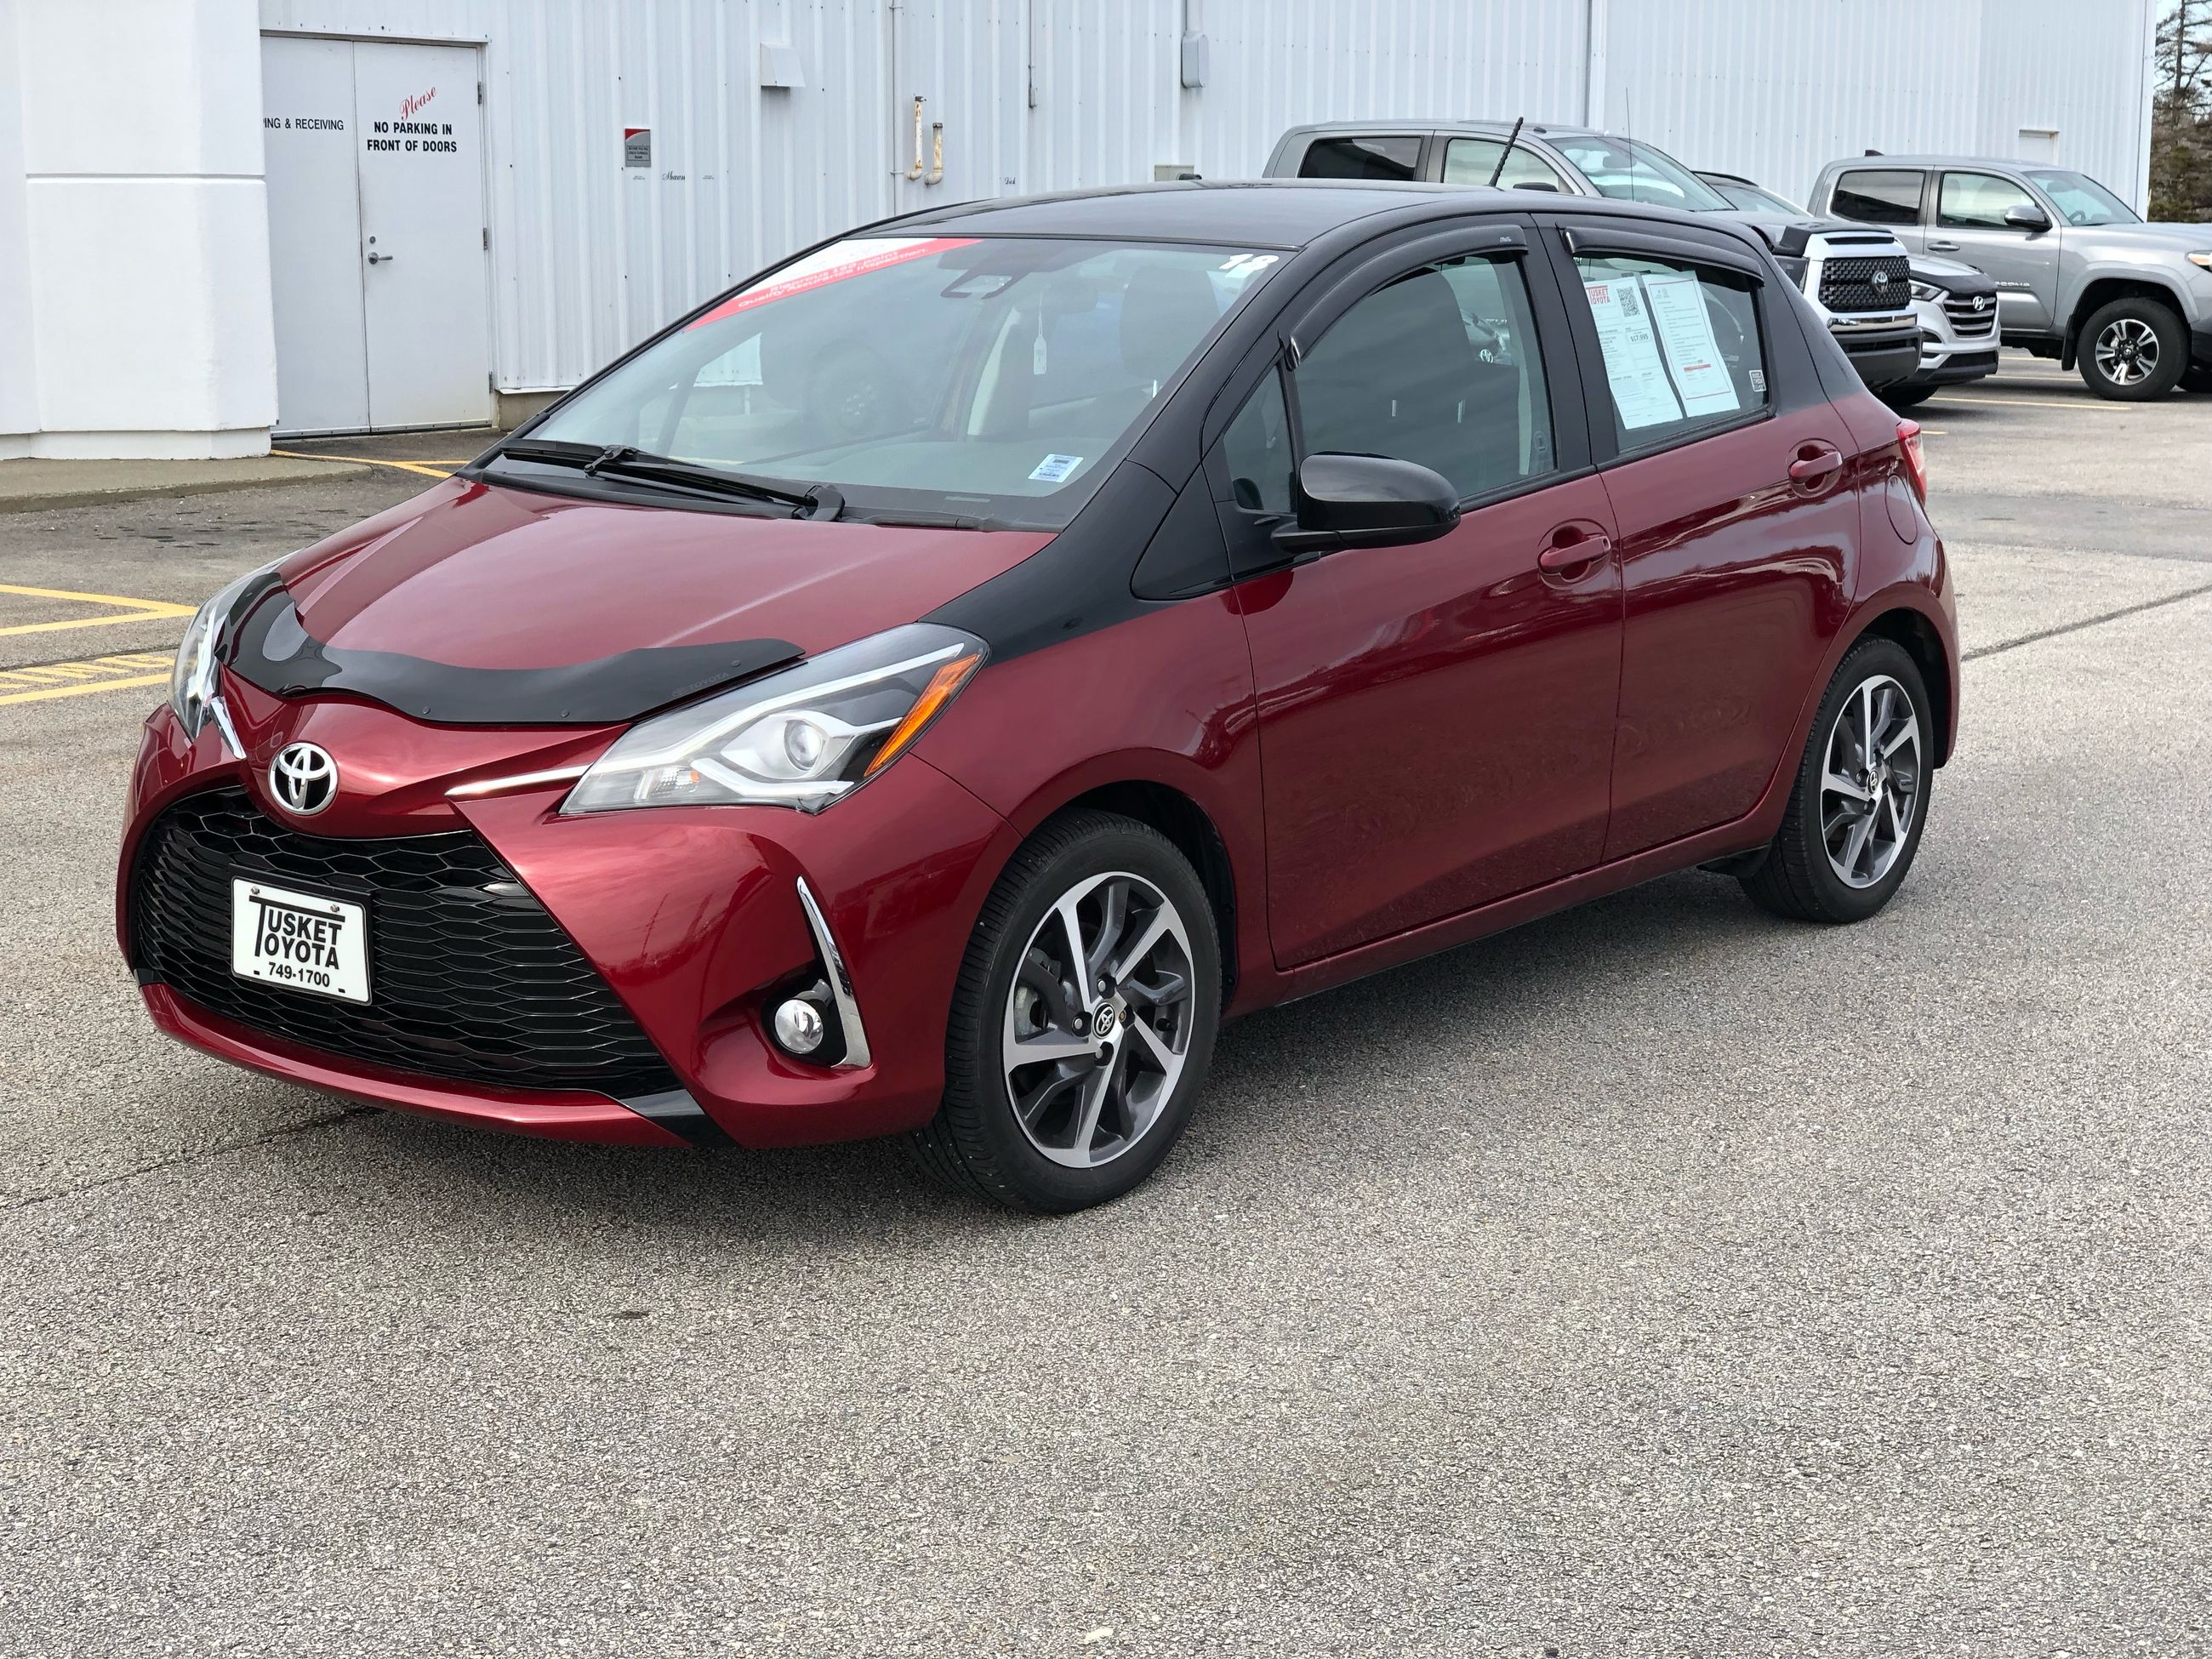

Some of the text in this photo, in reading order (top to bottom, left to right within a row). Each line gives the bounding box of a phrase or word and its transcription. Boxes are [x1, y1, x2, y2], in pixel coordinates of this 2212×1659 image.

[399, 86, 436, 121] Please
[263, 117, 345, 131] ING & RECEIVING
[374, 121, 453, 135] NO PARKING IN
[367, 139, 458, 153] FRONT OF DOORS
[249, 895, 345, 945] TUSKET
[269, 961, 330, 988] 749-1700
